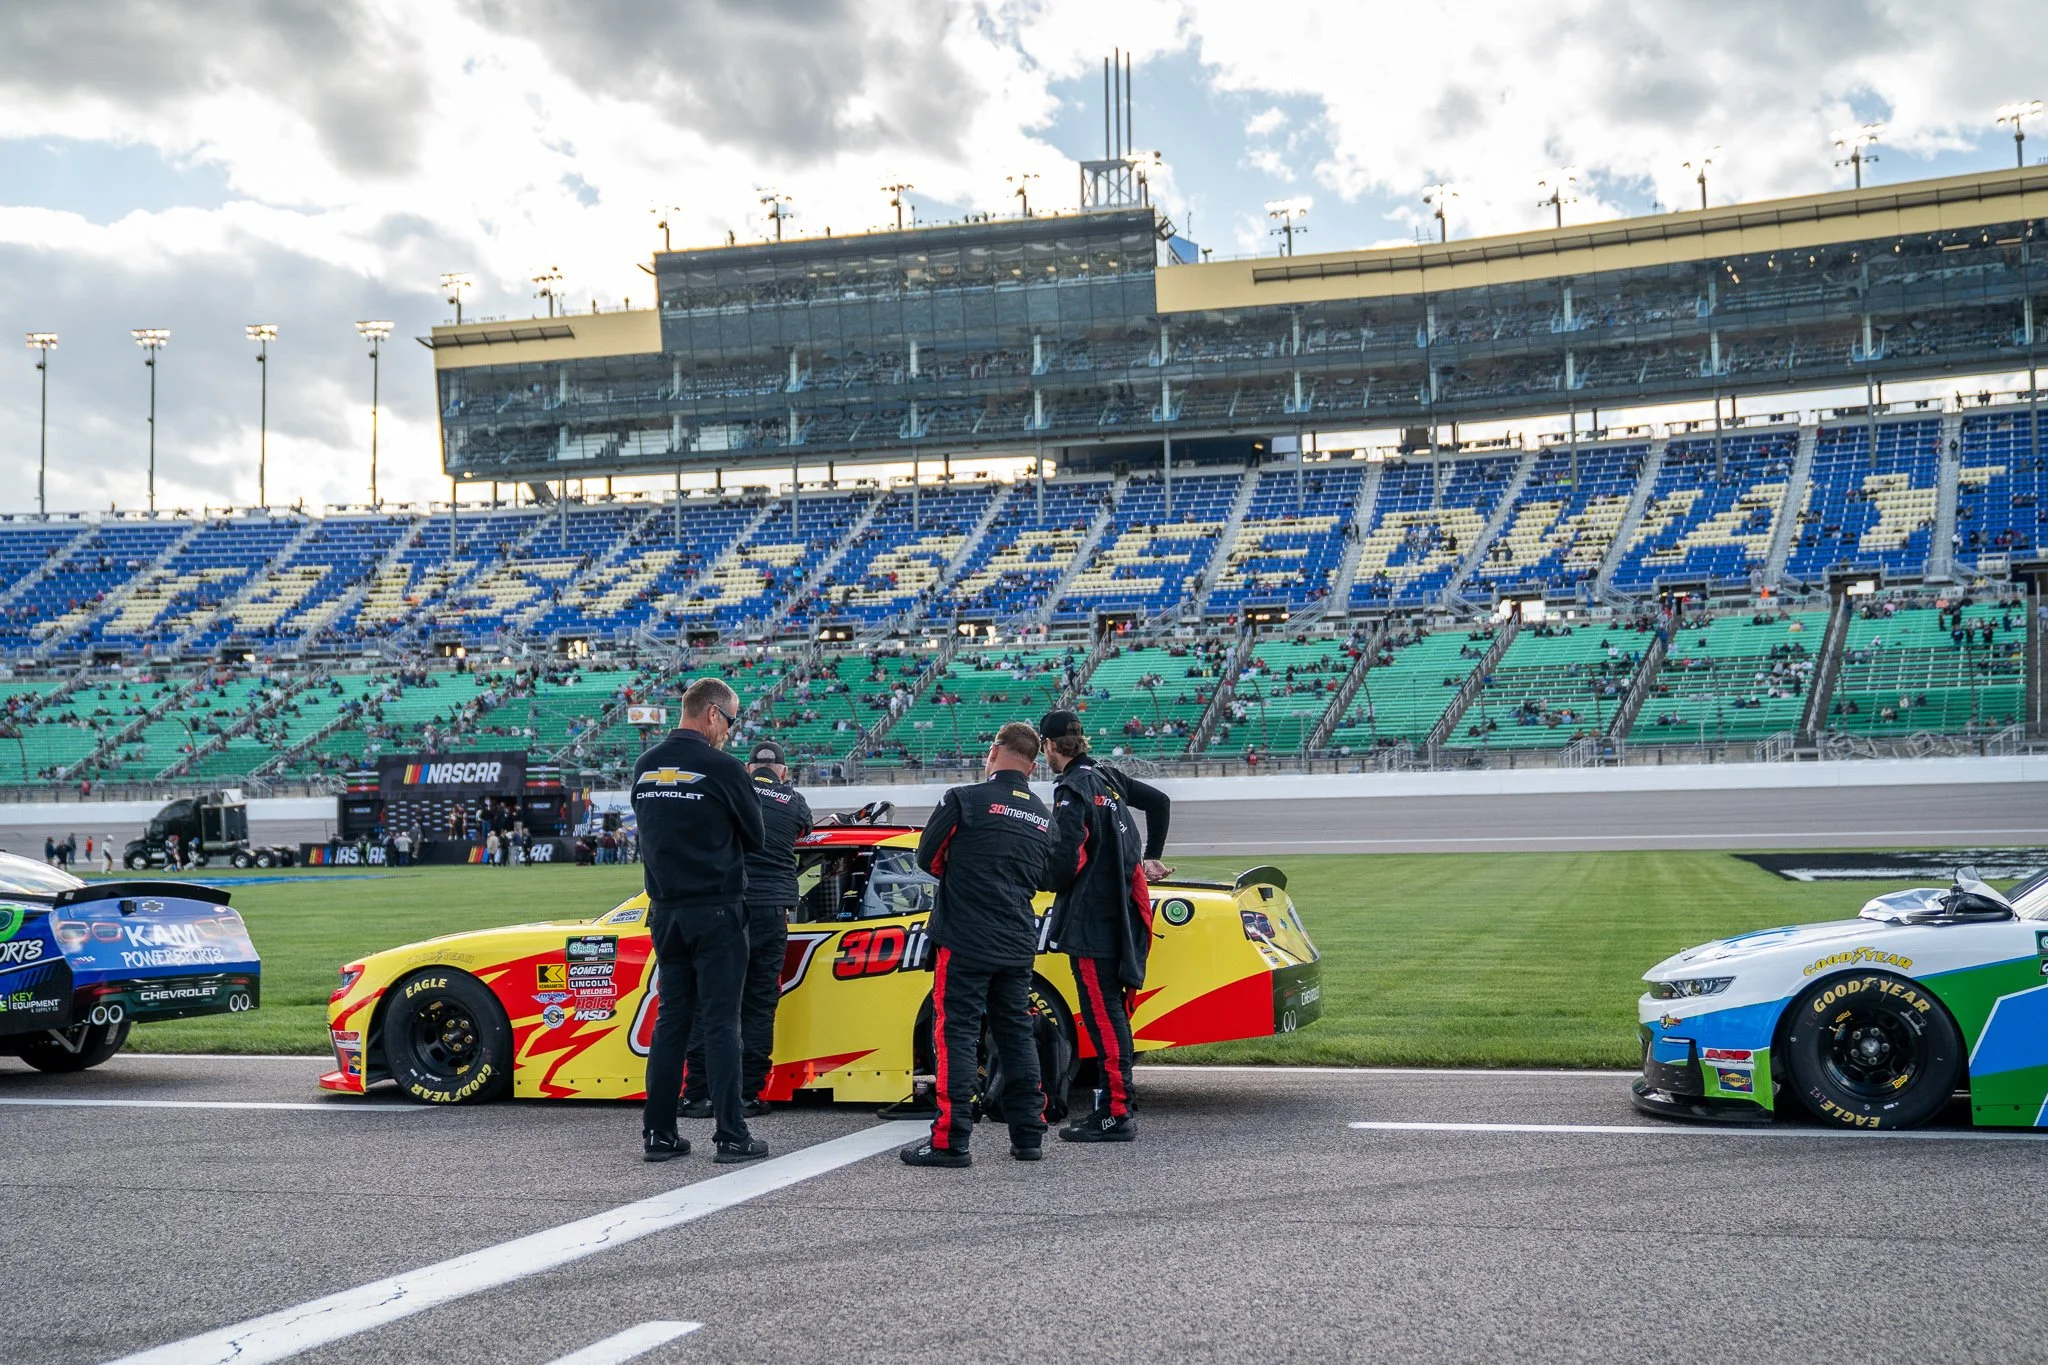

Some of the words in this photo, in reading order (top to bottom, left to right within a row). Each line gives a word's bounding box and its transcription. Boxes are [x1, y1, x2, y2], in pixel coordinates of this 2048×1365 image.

[828, 465, 2006, 604] SPEEDWAY
[426, 762, 503, 784] NASCAR
[636, 791, 704, 801] CHEVROLET
[989, 803, 1050, 828] 3Dimensional
[124, 923, 200, 948] KAM
[120, 947, 225, 968] POWERSPORTS
[1803, 946, 1913, 977] GOODYEAR
[405, 977, 448, 999] EAGLE
[571, 980, 608, 988] LINCOLN
[12, 991, 33, 1002] KEY
[140, 987, 218, 1001] CHEVROLET
[12, 999, 59, 1010] EQUIPMENT
[576, 996, 616, 1011] Holley
[1026, 987, 1058, 1027] AGLE
[574, 1010, 610, 1021] MSD
[1704, 1049, 1752, 1061] ARP
[1720, 1075, 1752, 1085] SUNOCO
[1820, 1100, 1881, 1128] EAGLE
